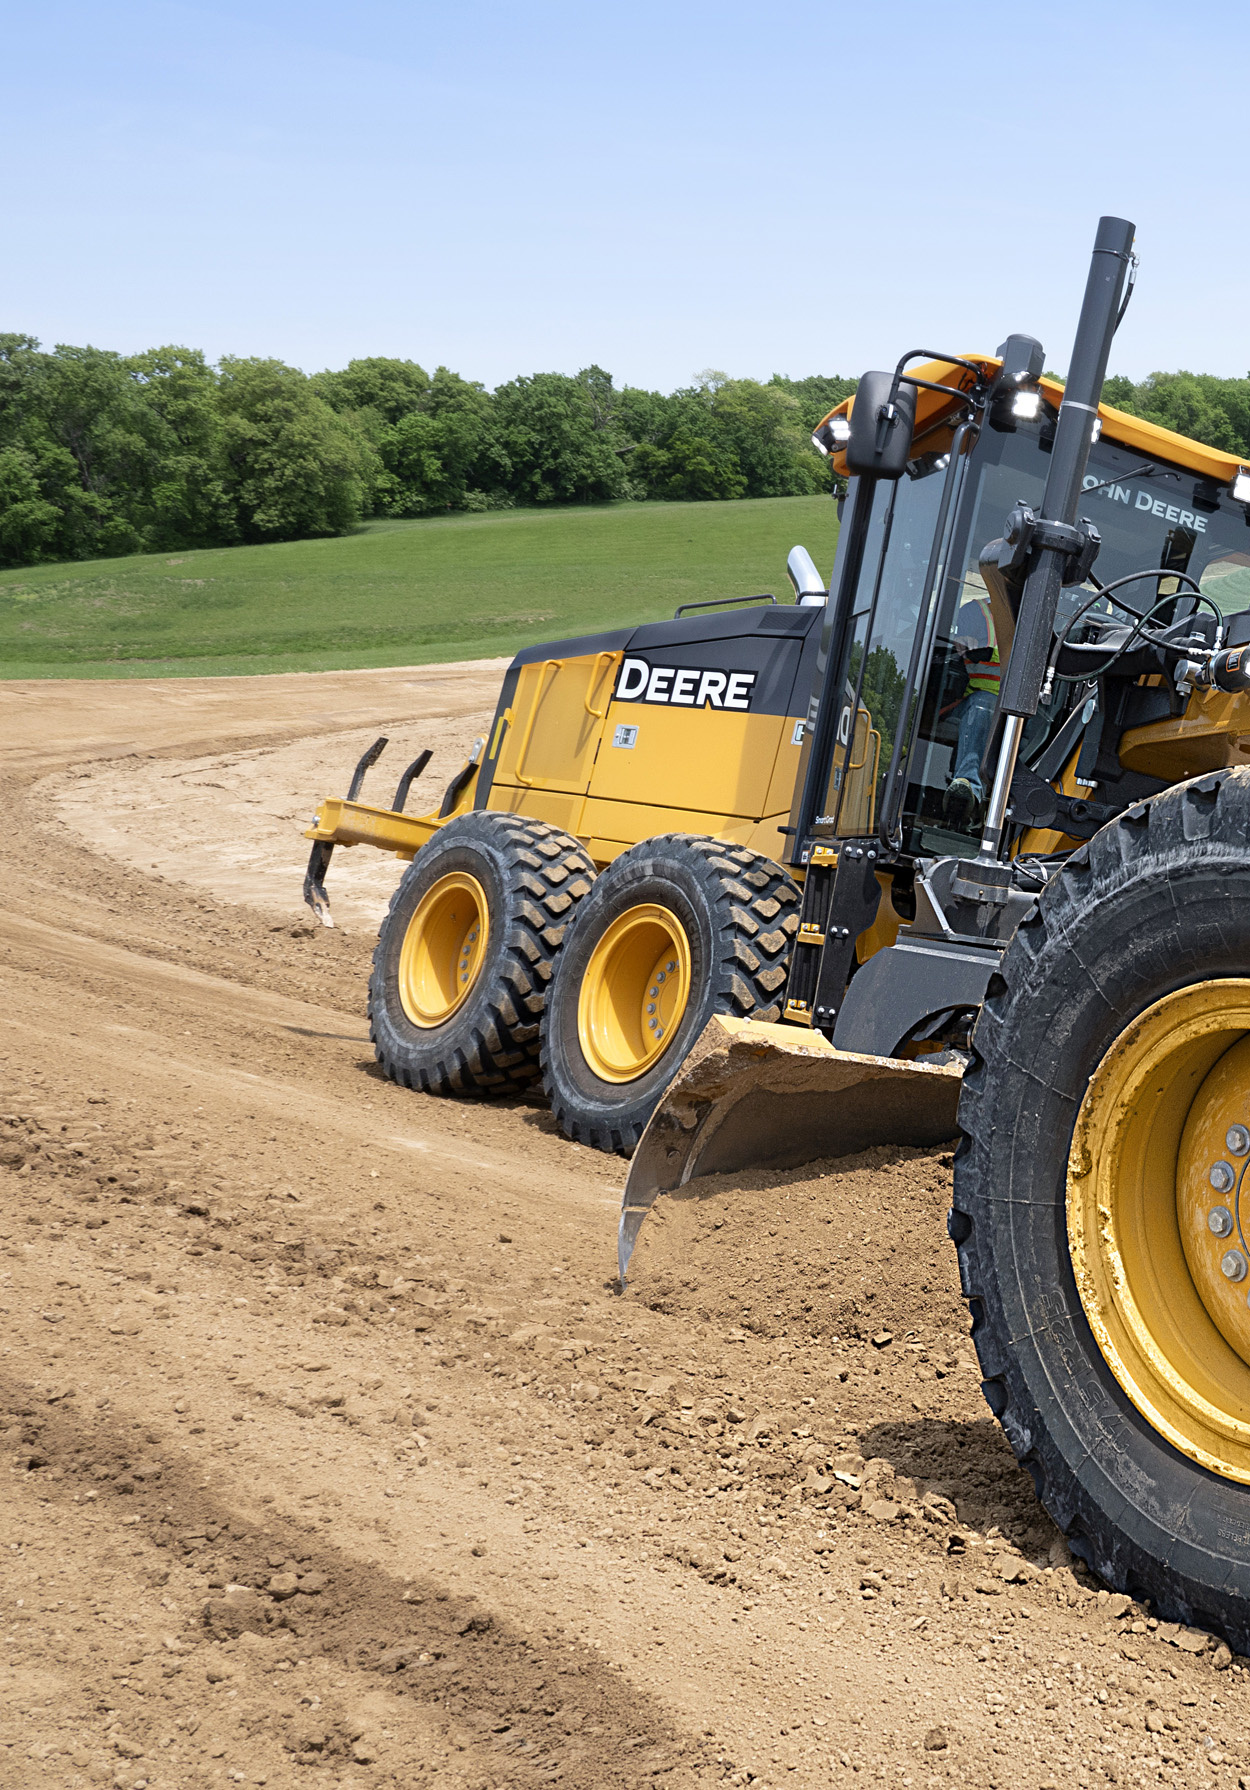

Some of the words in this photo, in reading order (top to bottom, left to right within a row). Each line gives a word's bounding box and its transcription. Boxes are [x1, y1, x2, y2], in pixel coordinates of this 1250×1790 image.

[1083, 474, 1131, 505] OHN
[1134, 490, 1209, 534] DEERE
[615, 657, 756, 710] DEERE
